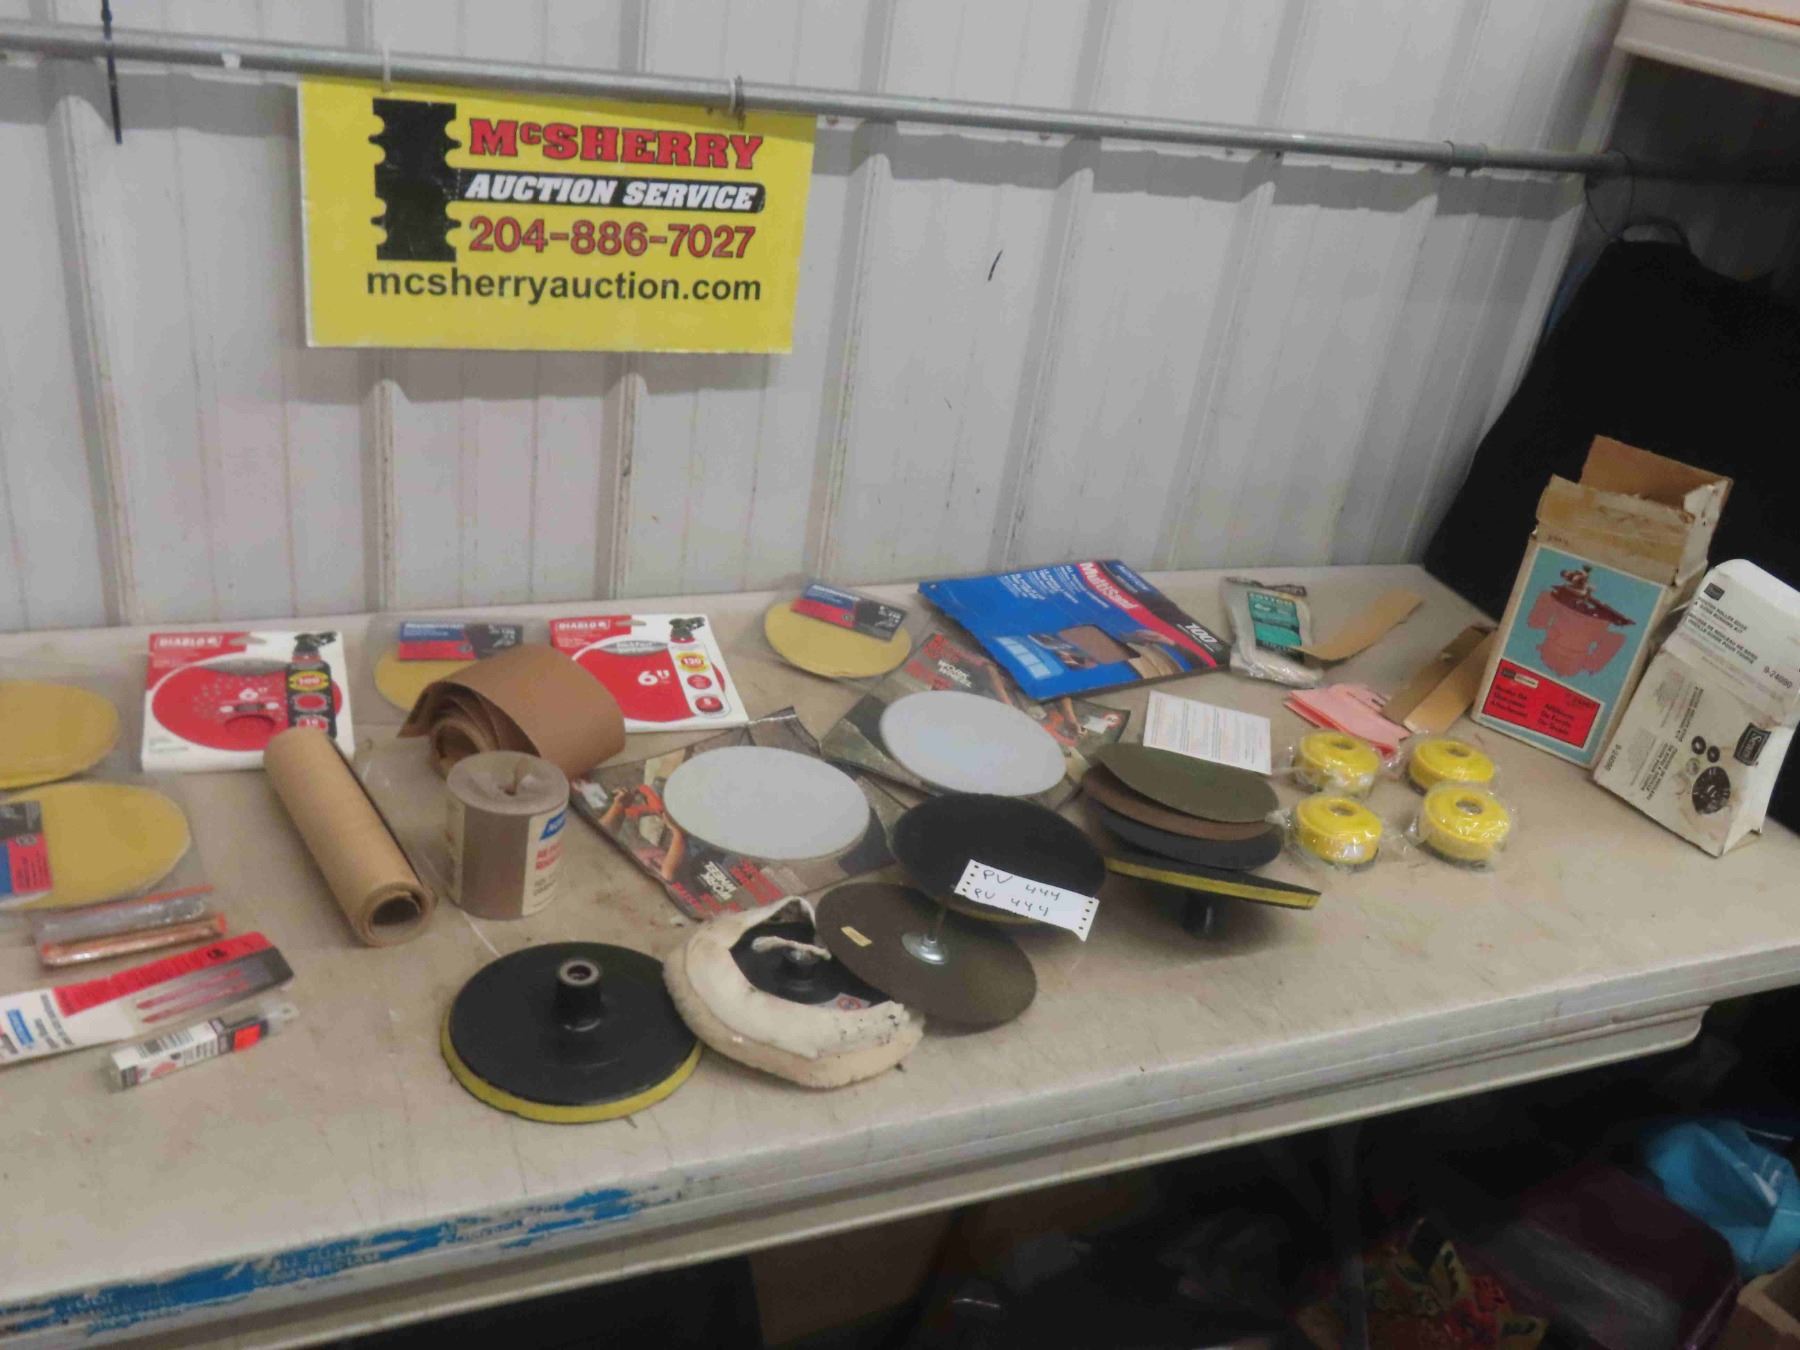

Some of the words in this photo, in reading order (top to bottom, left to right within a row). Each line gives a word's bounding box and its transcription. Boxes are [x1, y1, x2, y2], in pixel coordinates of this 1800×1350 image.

[465, 174, 617, 206] AUCTION
[622, 182, 758, 212] SERVICE
[468, 215, 757, 259] 204-886-7027
[367, 267, 762, 306] mcsherryauction.com
[558, 621, 597, 631] DIABLO
[159, 637, 206, 648] DIABLO
[701, 872, 733, 901] WORK
[1025, 884, 1061, 901] 444
[1010, 898, 1049, 917] 444
